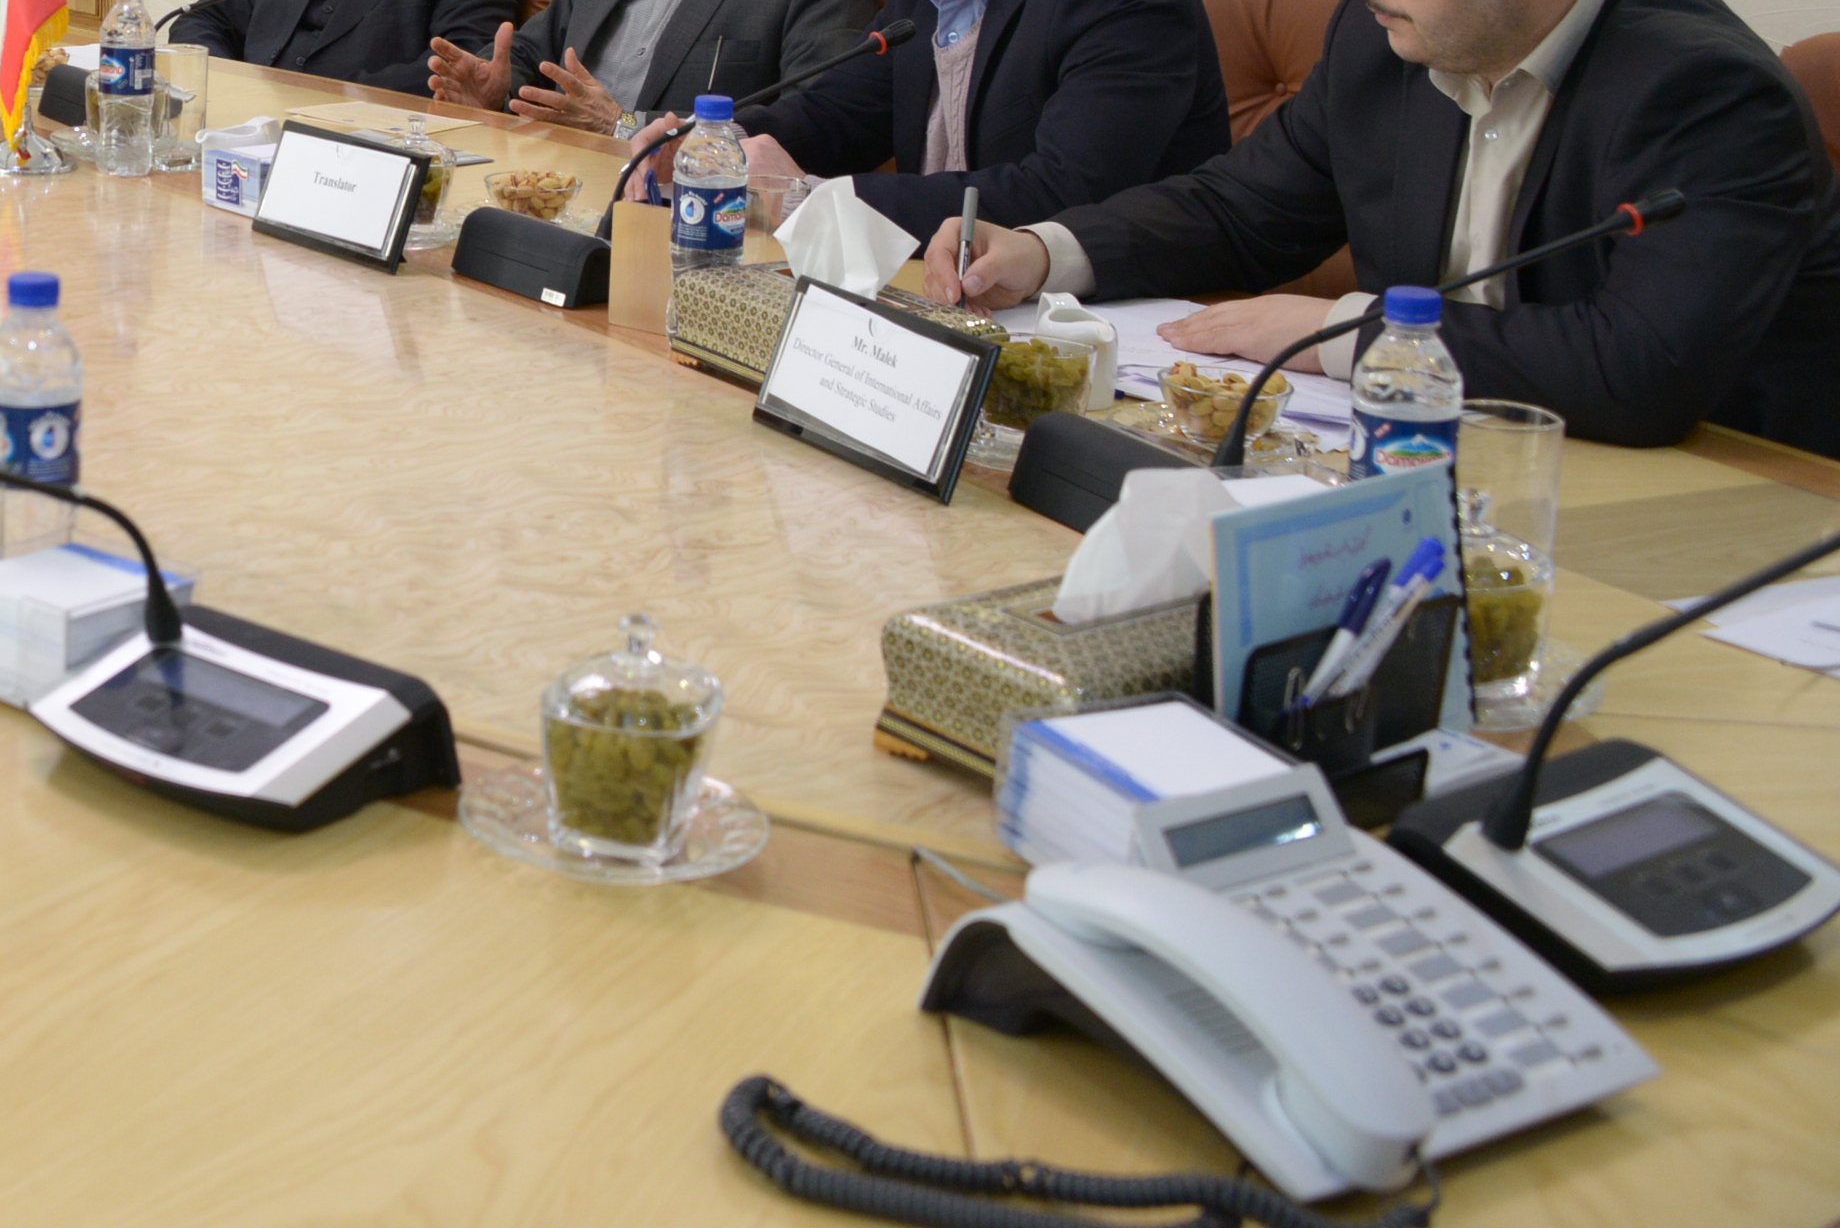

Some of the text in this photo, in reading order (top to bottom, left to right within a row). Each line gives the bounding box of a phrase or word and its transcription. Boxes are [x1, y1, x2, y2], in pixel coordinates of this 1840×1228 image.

[313, 171, 357, 193] Translator
[851, 335, 898, 369] Mr. Malek
[792, 337, 943, 421] Director General of International Affairs
[818, 376, 896, 422] and Strategic Studies
